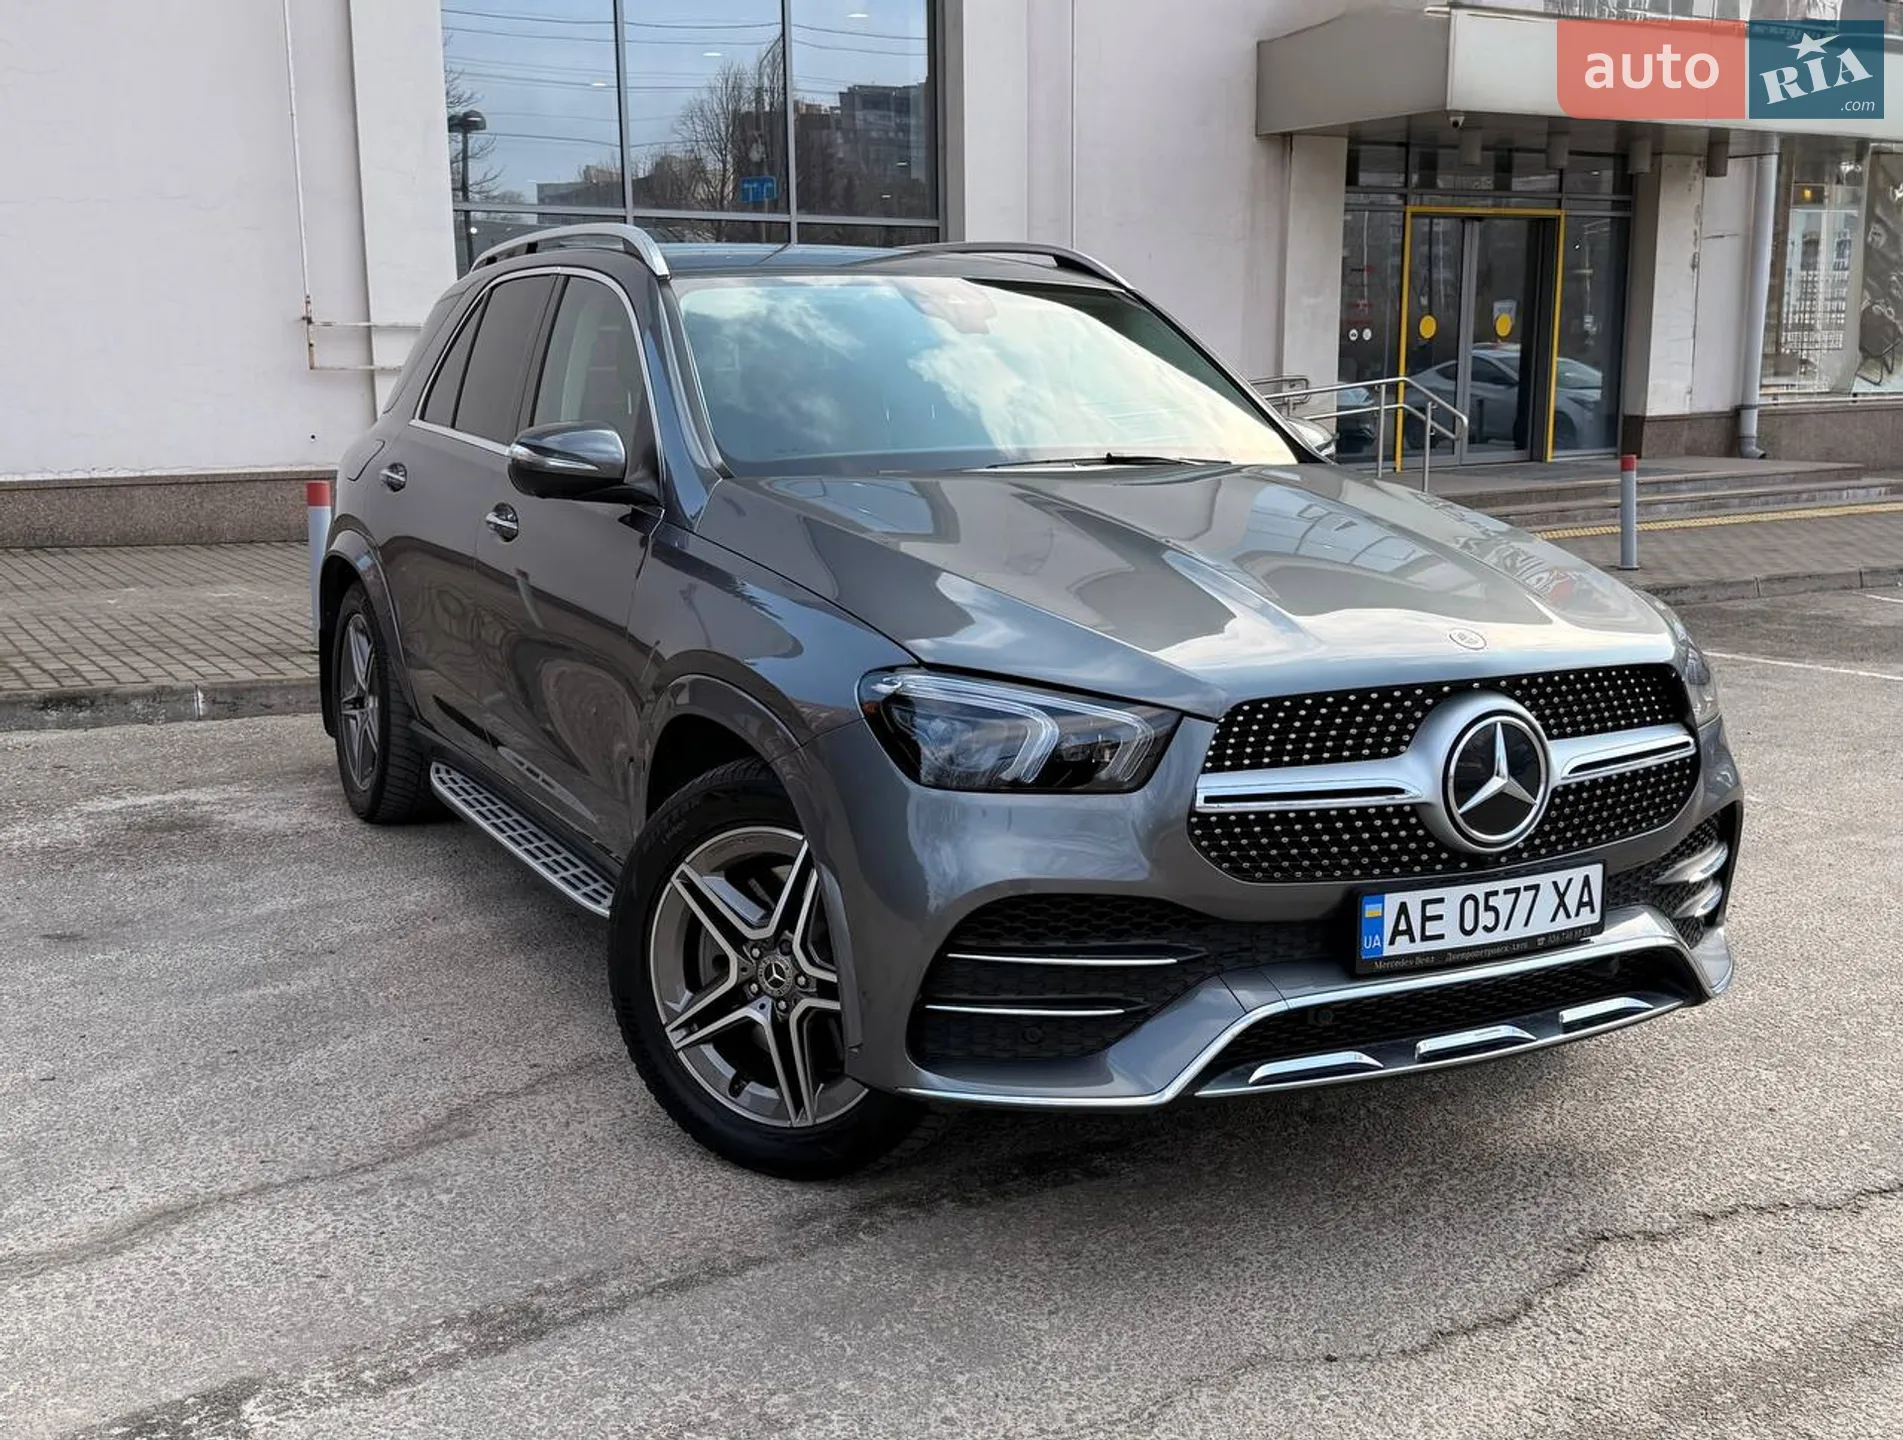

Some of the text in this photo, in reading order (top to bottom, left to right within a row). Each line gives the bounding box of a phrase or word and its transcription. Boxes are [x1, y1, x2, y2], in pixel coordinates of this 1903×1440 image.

[1388, 897, 1446, 946] AE
[1459, 883, 1541, 936] 0577
[1550, 874, 1596, 923] XA
[1364, 933, 1382, 949] UA
